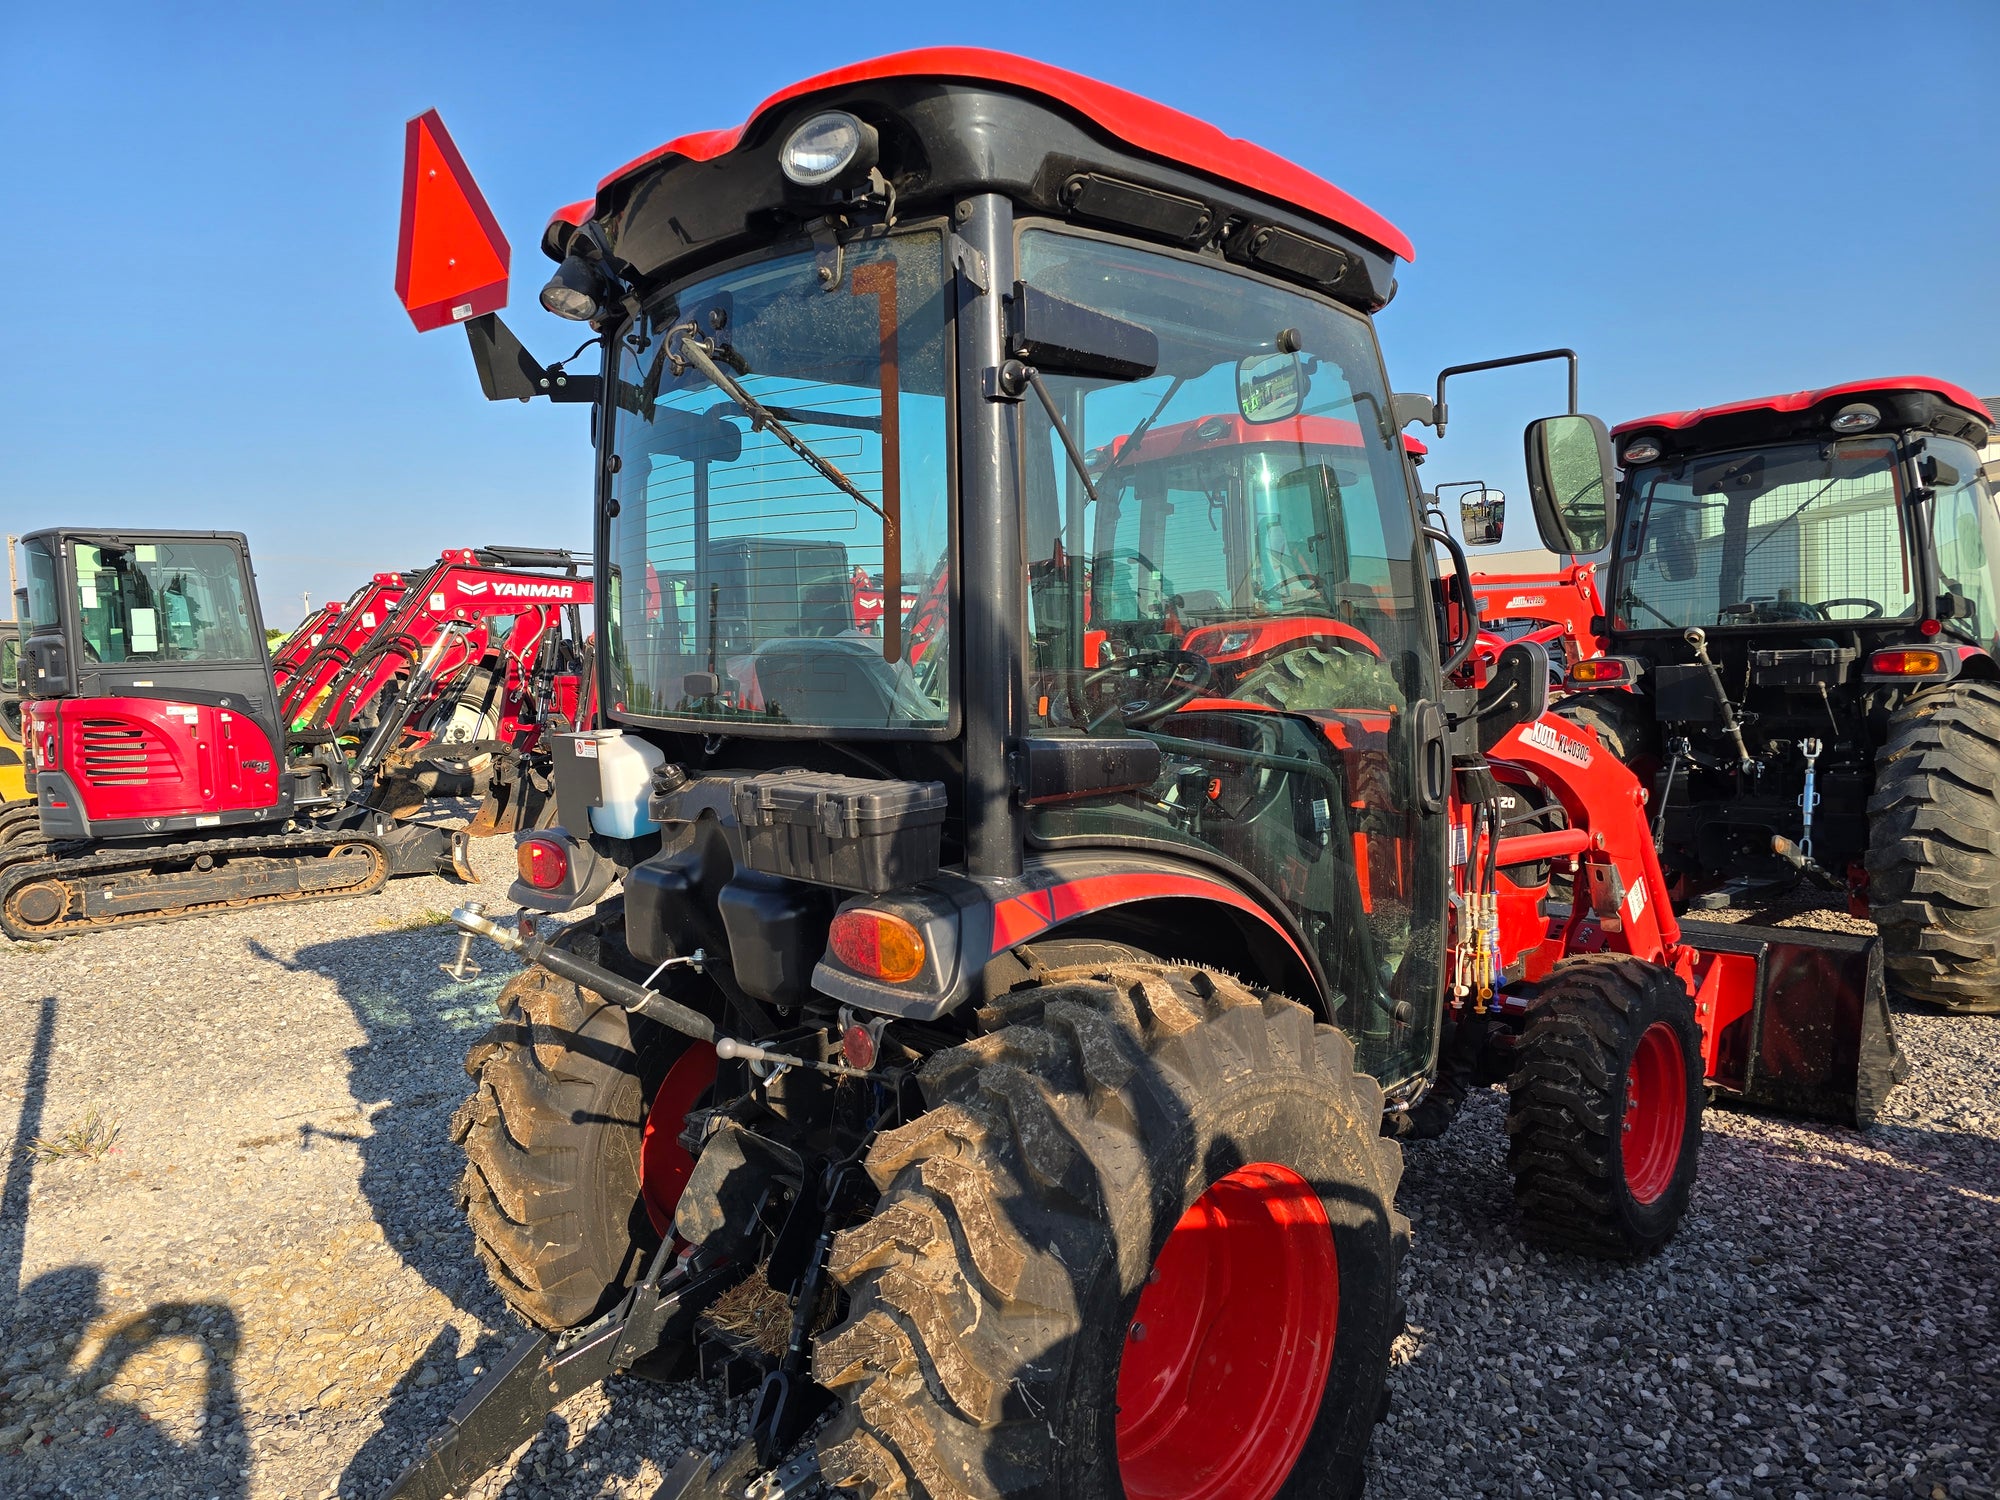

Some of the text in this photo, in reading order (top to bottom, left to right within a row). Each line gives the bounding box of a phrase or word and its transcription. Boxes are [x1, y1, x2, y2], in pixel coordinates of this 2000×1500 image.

[491, 582, 573, 599] YANMAR
[1532, 721, 1590, 762] KIOTI KL4030C
